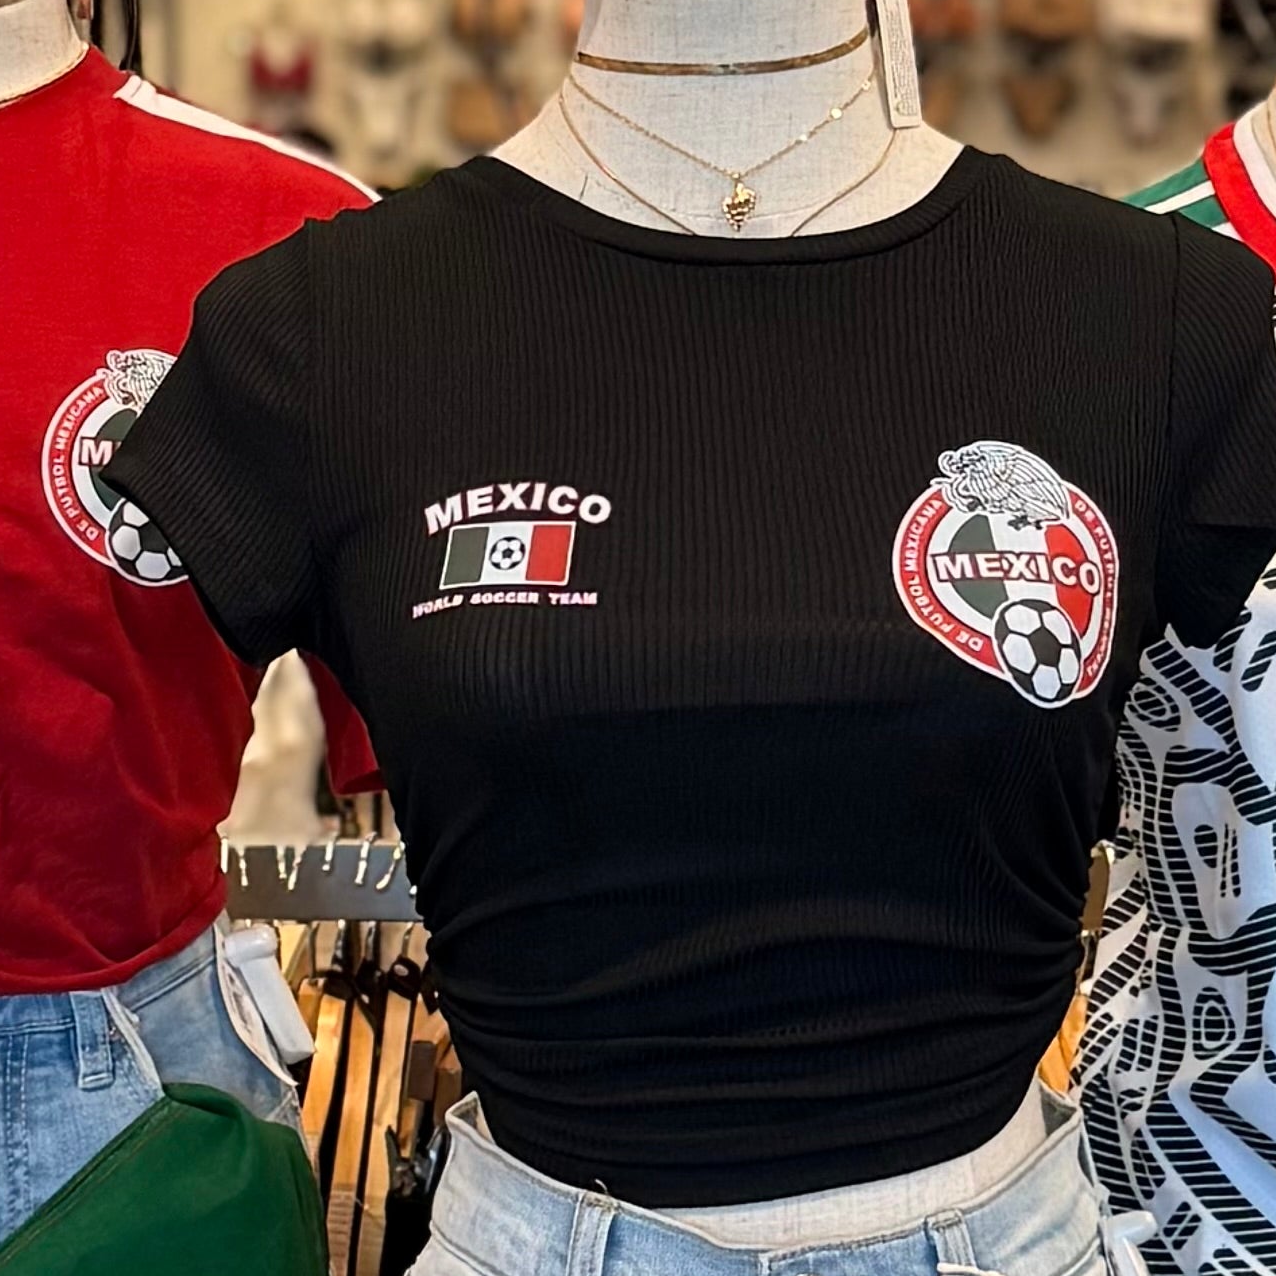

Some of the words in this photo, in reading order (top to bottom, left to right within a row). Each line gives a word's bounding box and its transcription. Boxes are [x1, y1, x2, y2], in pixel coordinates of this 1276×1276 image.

[424, 482, 611, 535] MEXICO
[931, 552, 1101, 595] MEXICO
[412, 594, 464, 618] WORLD
[470, 592, 539, 604] SOCCER
[548, 592, 598, 605] TEAM
